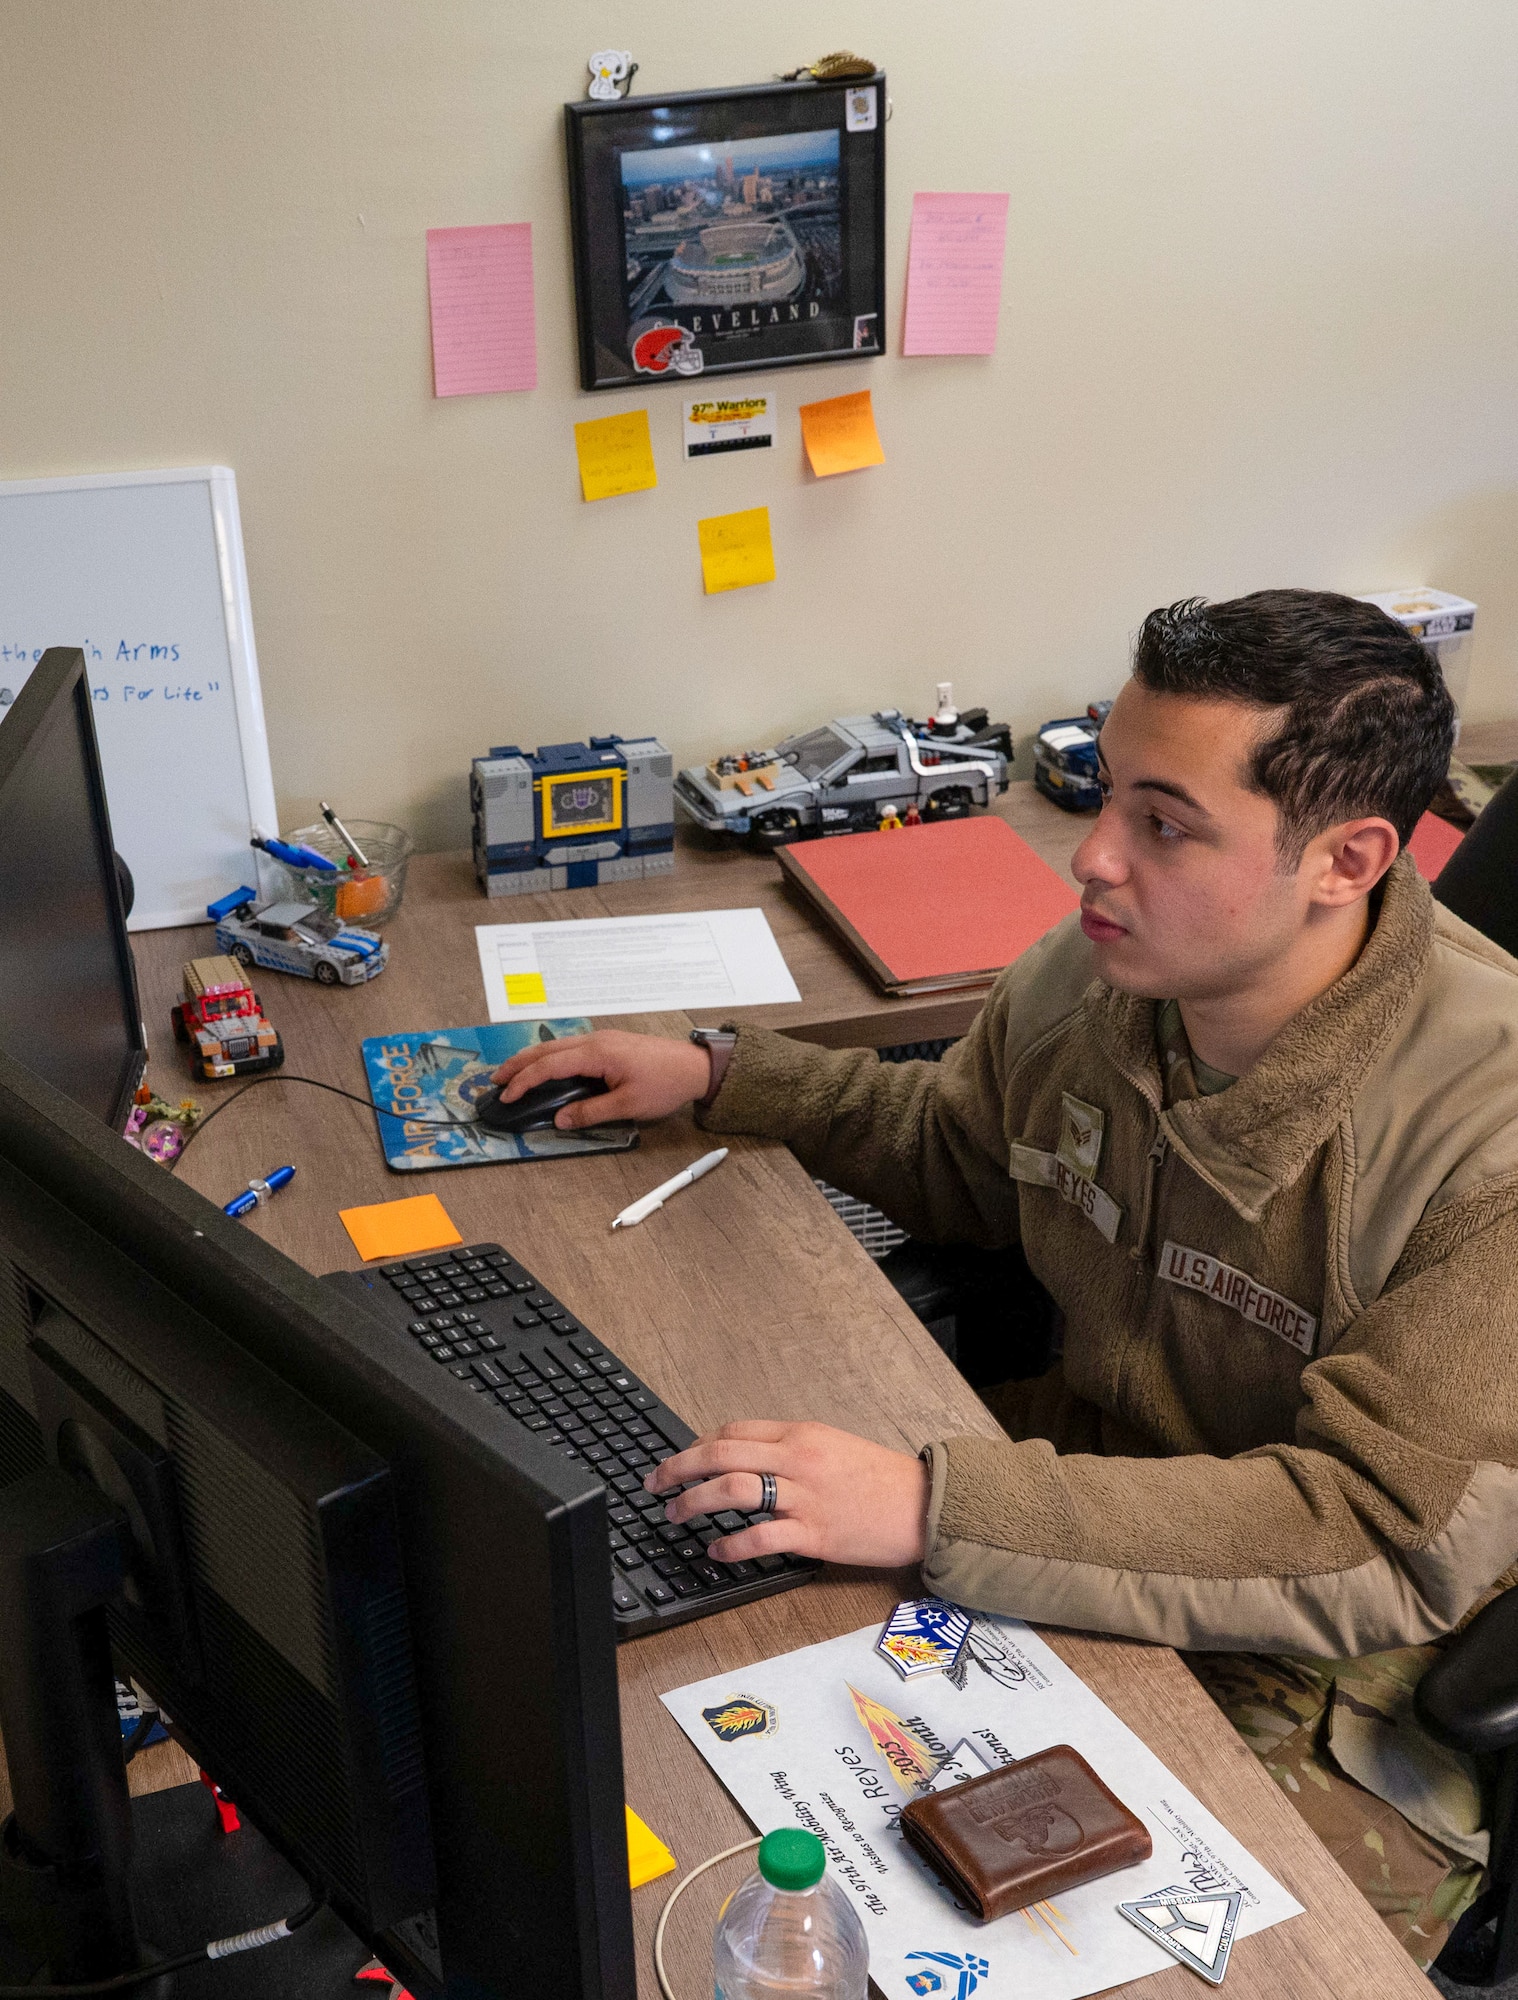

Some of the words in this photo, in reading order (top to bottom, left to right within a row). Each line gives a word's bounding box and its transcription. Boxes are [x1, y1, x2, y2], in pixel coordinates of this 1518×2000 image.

[654, 302, 820, 332] CLEVELAND
[692, 402, 714, 414] 97th
[716, 397, 767, 411] Warriors
[115, 640, 180, 662] Arms
[382, 1043, 426, 1117] FORCE
[404, 1119, 439, 1156] AIR
[1055, 1163, 1096, 1215] REYES
[877, 1741, 923, 1776] 2025
[898, 1715, 963, 1772] Month
[769, 1771, 797, 1802] Wing
[834, 1746, 890, 1800] Reyes
[819, 1791, 857, 1834] Recognize
[1160, 1799, 1175, 1815] Wing
[792, 1801, 835, 1847] Mobility
[852, 1832, 865, 1843] to
[1174, 1813, 1195, 1837] Mobility
[827, 1845, 853, 1865] Air
[860, 1842, 889, 1875] Wishes
[838, 1865, 872, 1893] 97th
[864, 1893, 889, 1916] The
[1160, 1895, 1199, 1907] MISSION
[1152, 1925, 1184, 1951] AIRMEN
[1218, 1919, 1234, 1953] CULTURE
